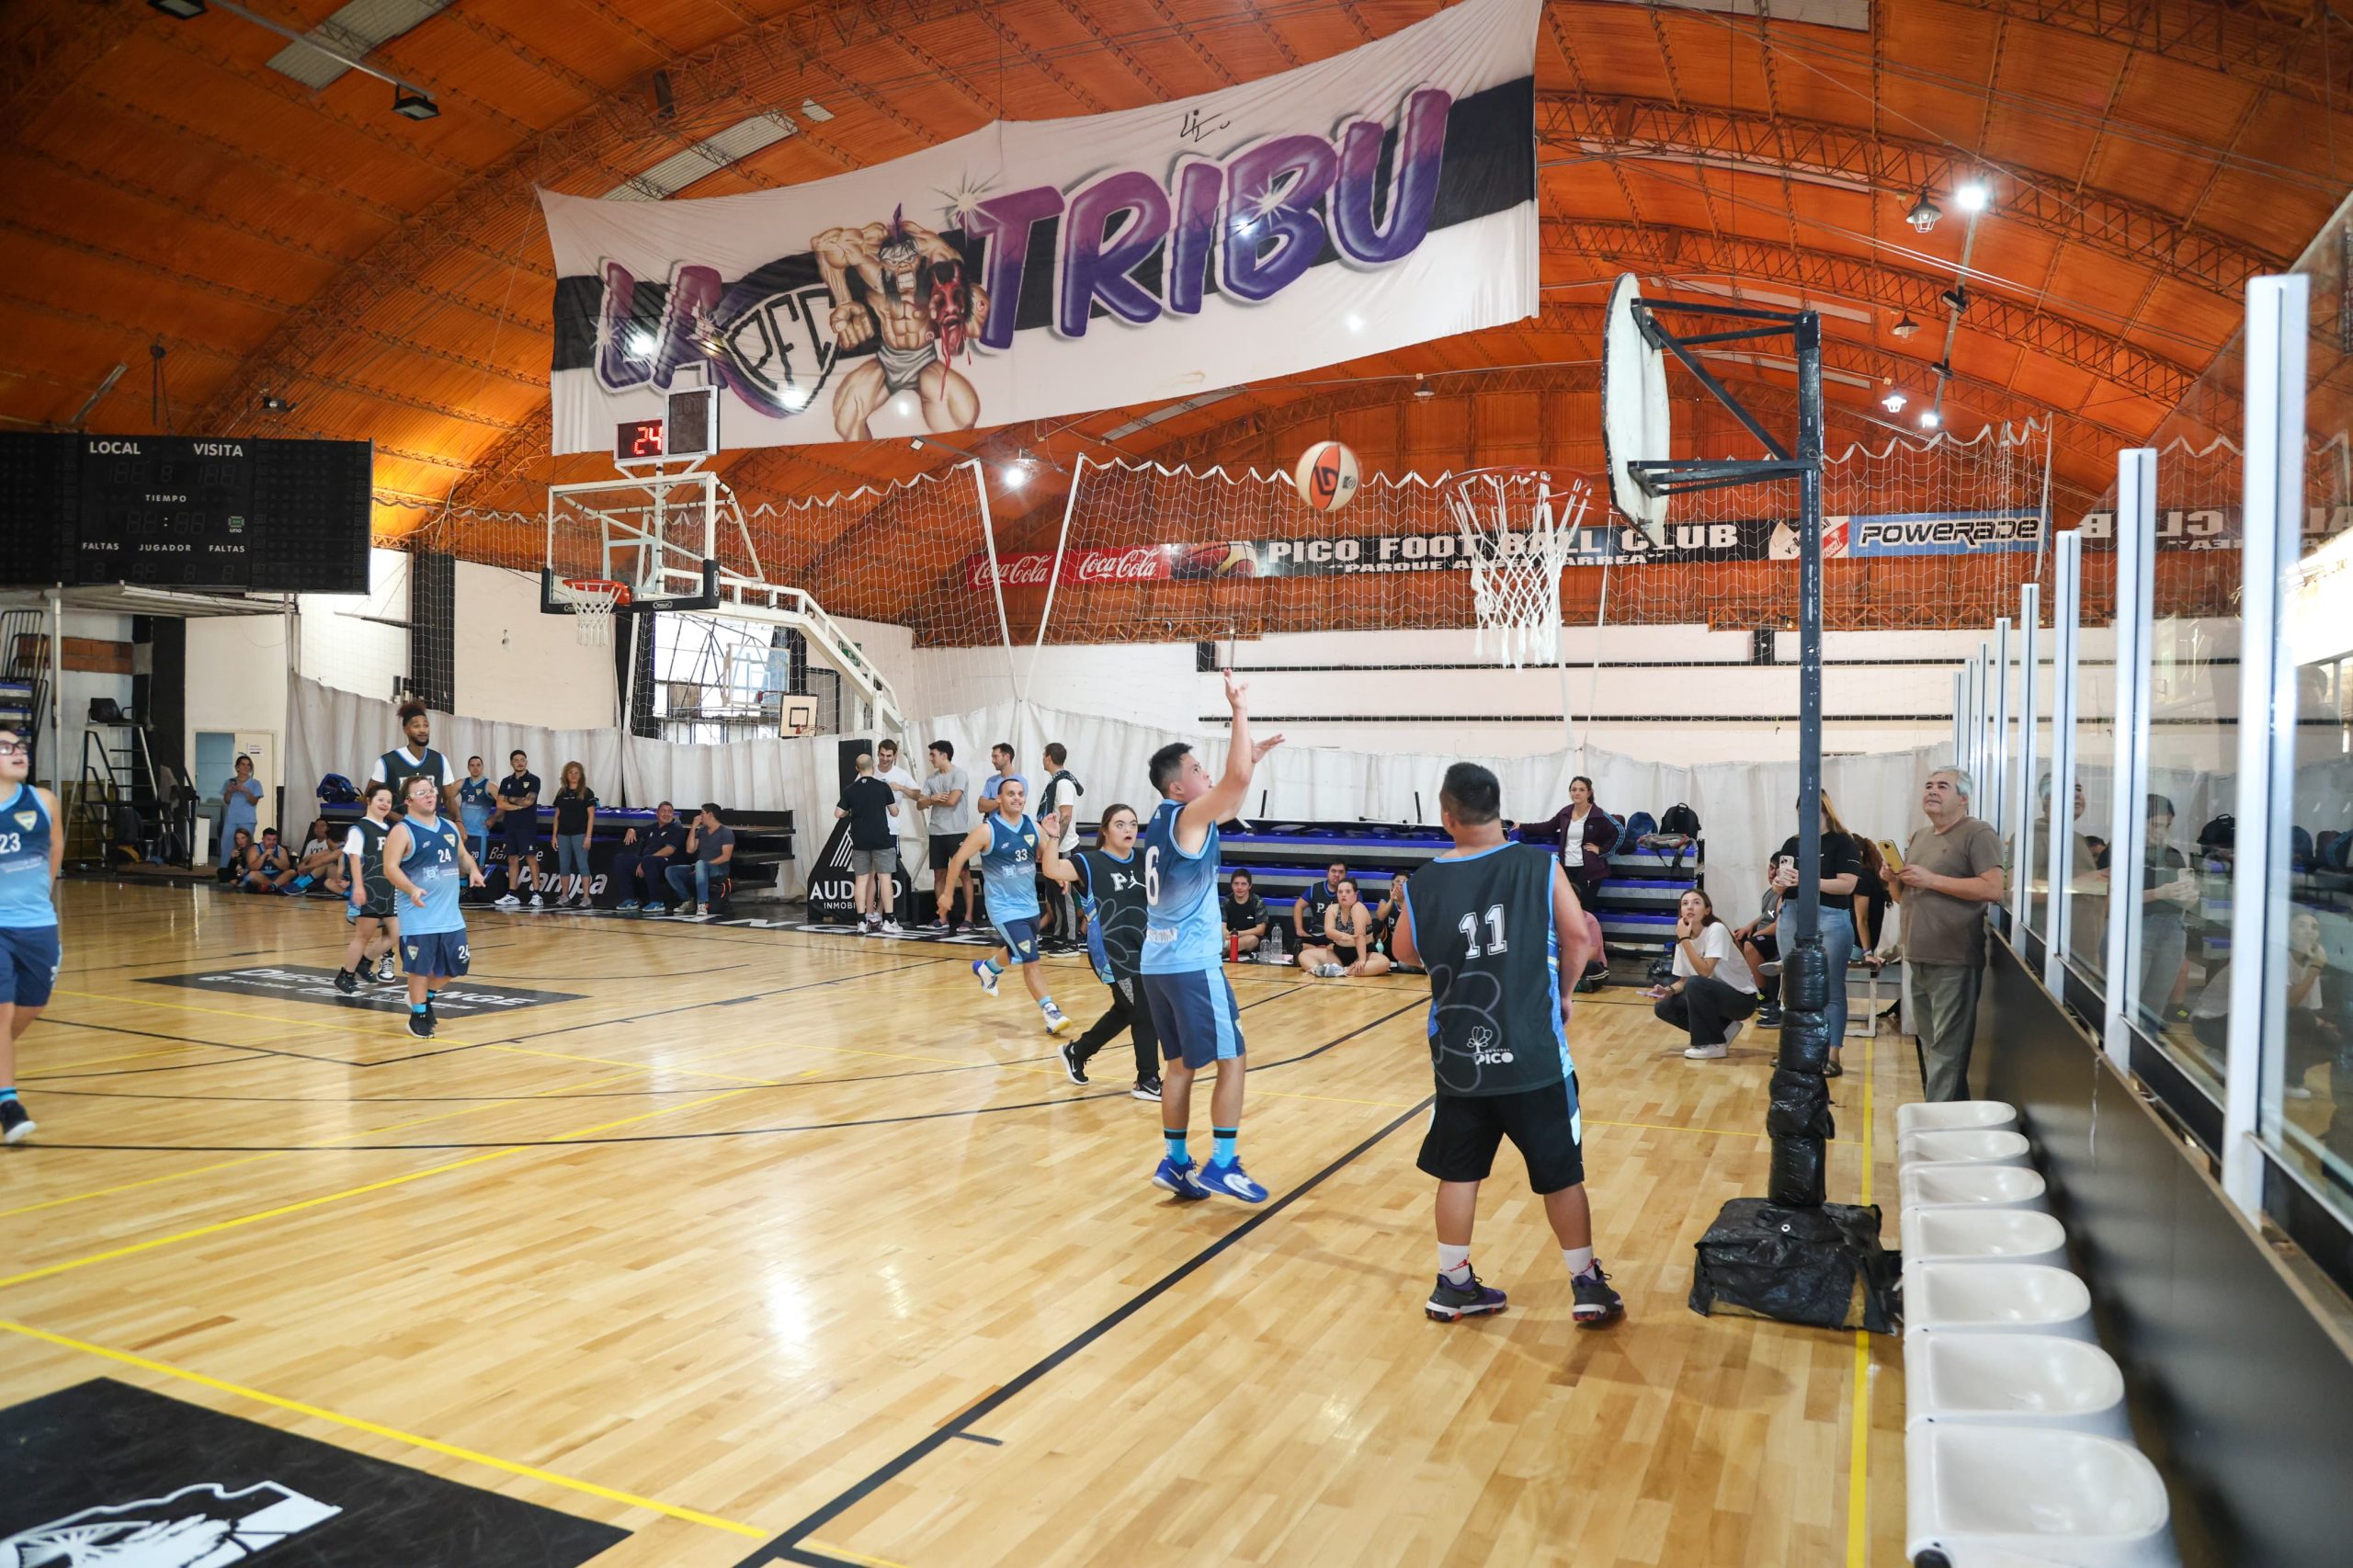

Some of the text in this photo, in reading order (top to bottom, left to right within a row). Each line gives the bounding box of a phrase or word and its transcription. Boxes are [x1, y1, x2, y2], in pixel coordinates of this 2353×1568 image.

[965, 86, 1453, 352] TRIBU
[89, 440, 142, 455] LOCAL
[633, 426, 663, 456] 24
[193, 442, 244, 458] VISITA
[145, 494, 188, 503] TIEMPO
[82, 541, 120, 551] FALTAS
[139, 543, 192, 552] JUGADOR
[208, 544, 245, 553] FALTAS
[1268, 539, 1360, 563] PICO
[1078, 549, 1162, 581] Coca-Cola
[467, 794, 476, 803] 20
[0, 832, 22, 855] 23
[437, 847, 453, 864] 24
[471, 850, 481, 859] 20
[1014, 848, 1029, 862] 33
[1145, 846, 1160, 906] 6
[1458, 903, 1508, 960] 11
